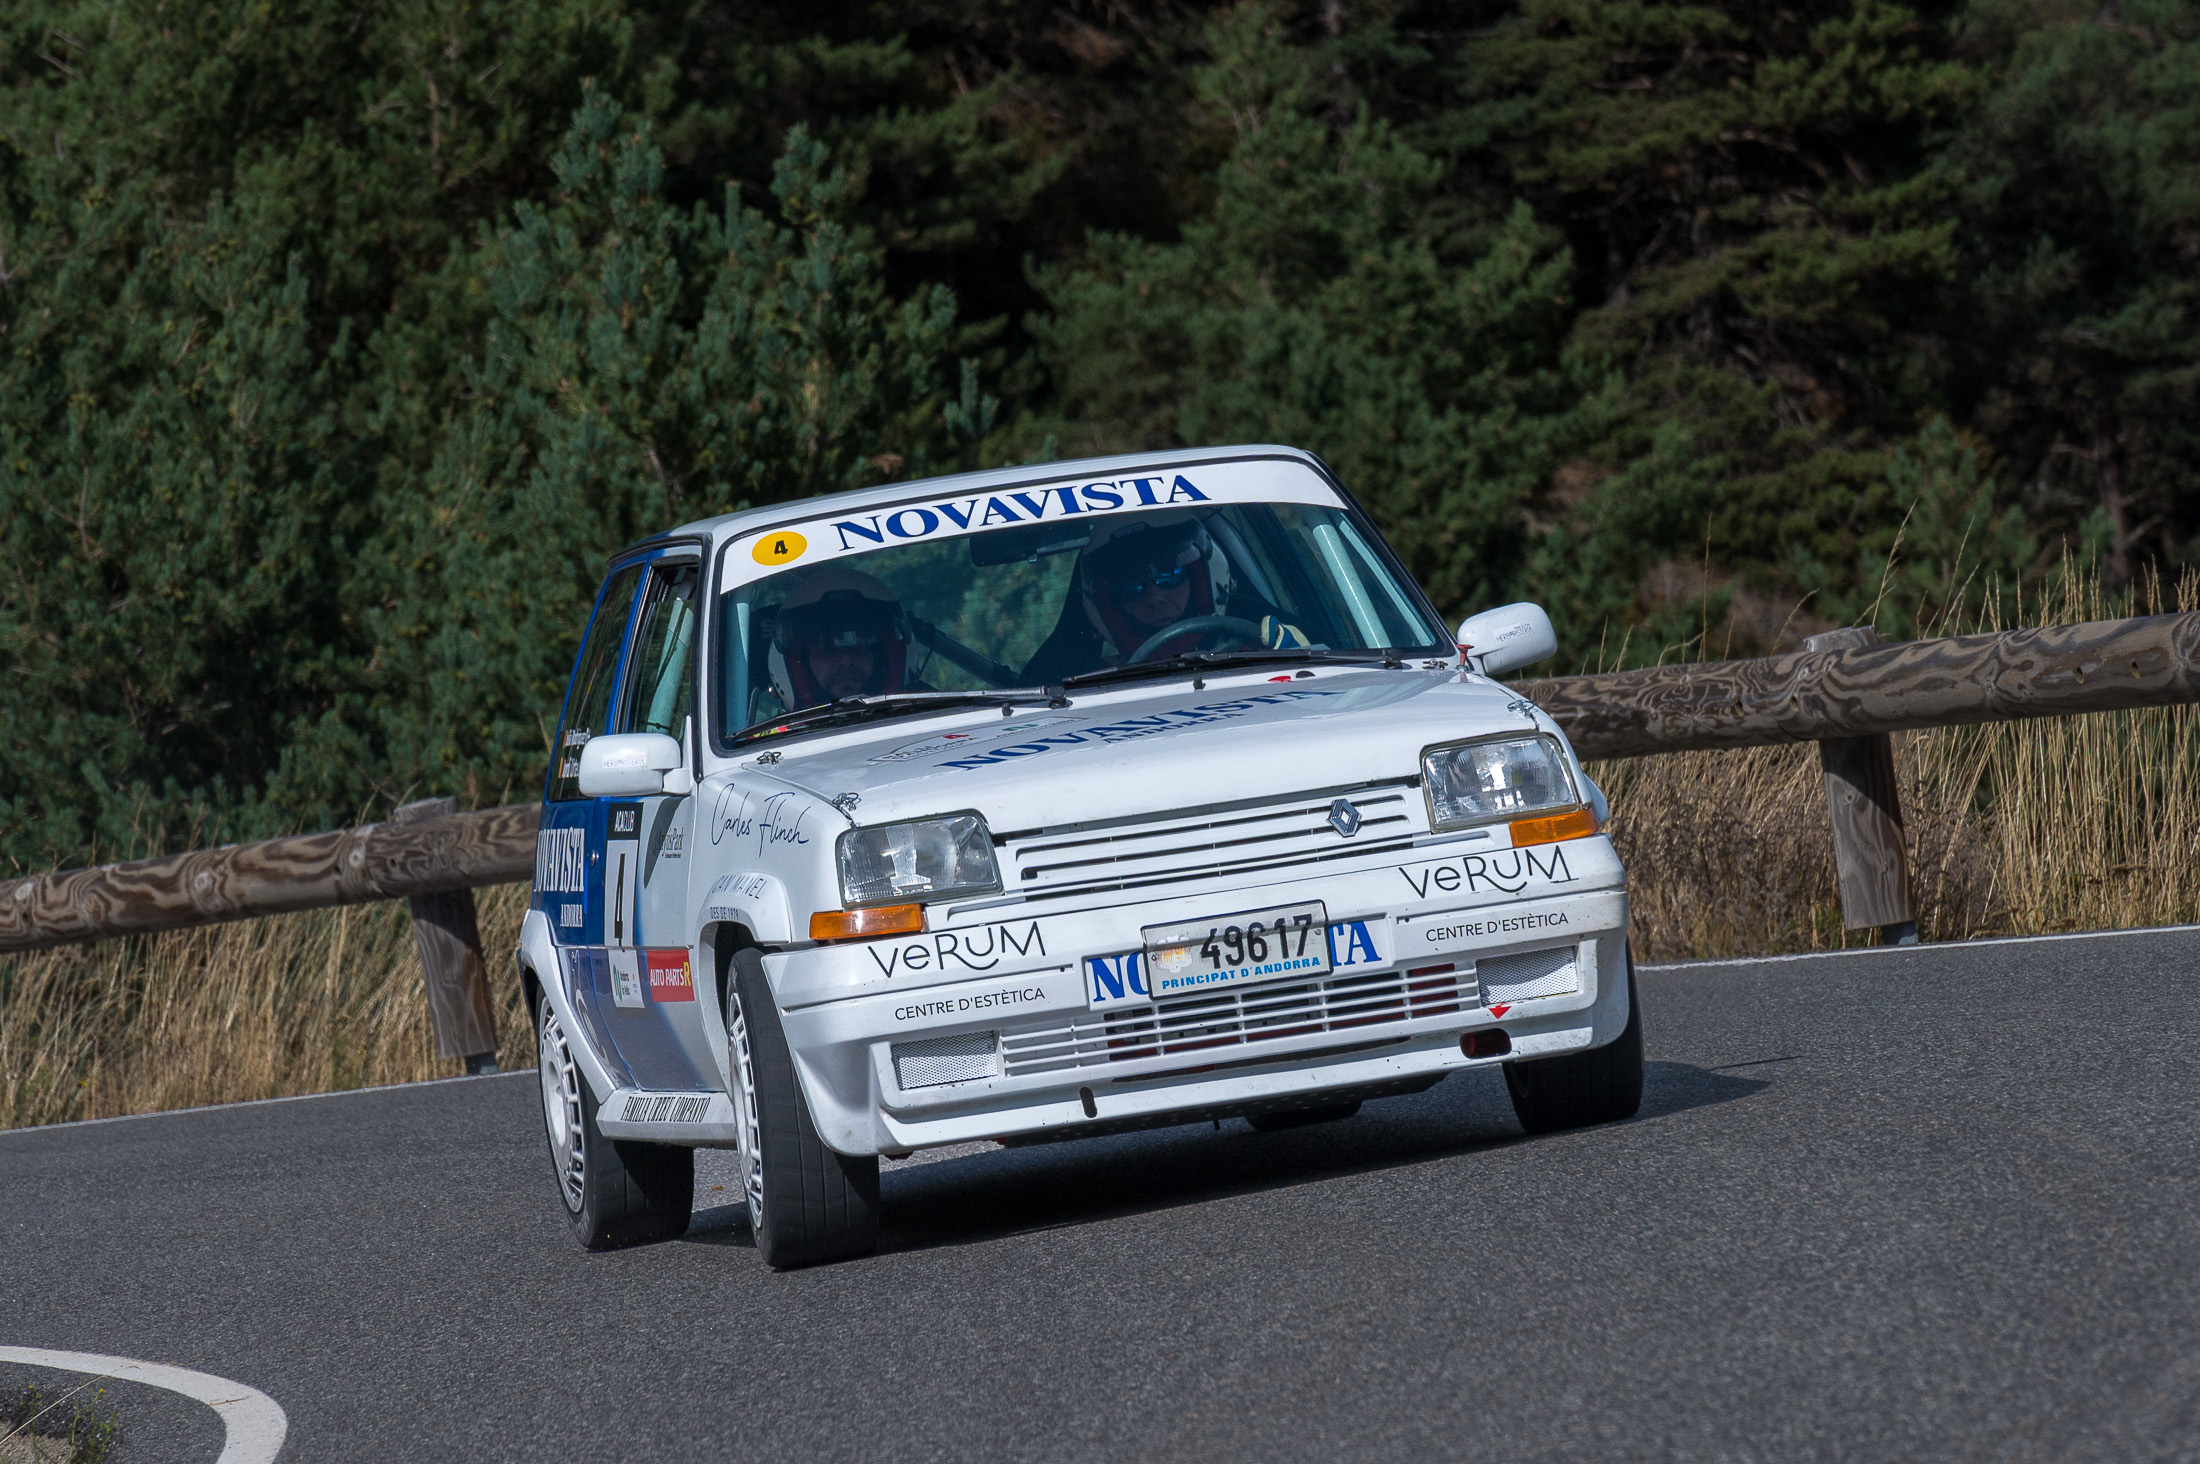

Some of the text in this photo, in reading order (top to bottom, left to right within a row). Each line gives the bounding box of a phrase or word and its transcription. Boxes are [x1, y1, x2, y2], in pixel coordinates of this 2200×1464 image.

[829, 475, 1212, 551] NOVAVISTA
[773, 539, 789, 555] 4
[932, 690, 1347, 771] NOVAVISTA
[1103, 713, 1249, 744] ANDORRA
[711, 783, 812, 858] Carles Flinch
[614, 853, 626, 951] 4
[1201, 913, 1312, 969] 49617
[1426, 912, 1569, 942] CENTRE D'ESTÈTICA
[650, 968, 665, 987] AUTO
[1161, 969, 1236, 990] PRINCIPAT
[894, 987, 1046, 1021] CENTRE D'ESTÈTICA
